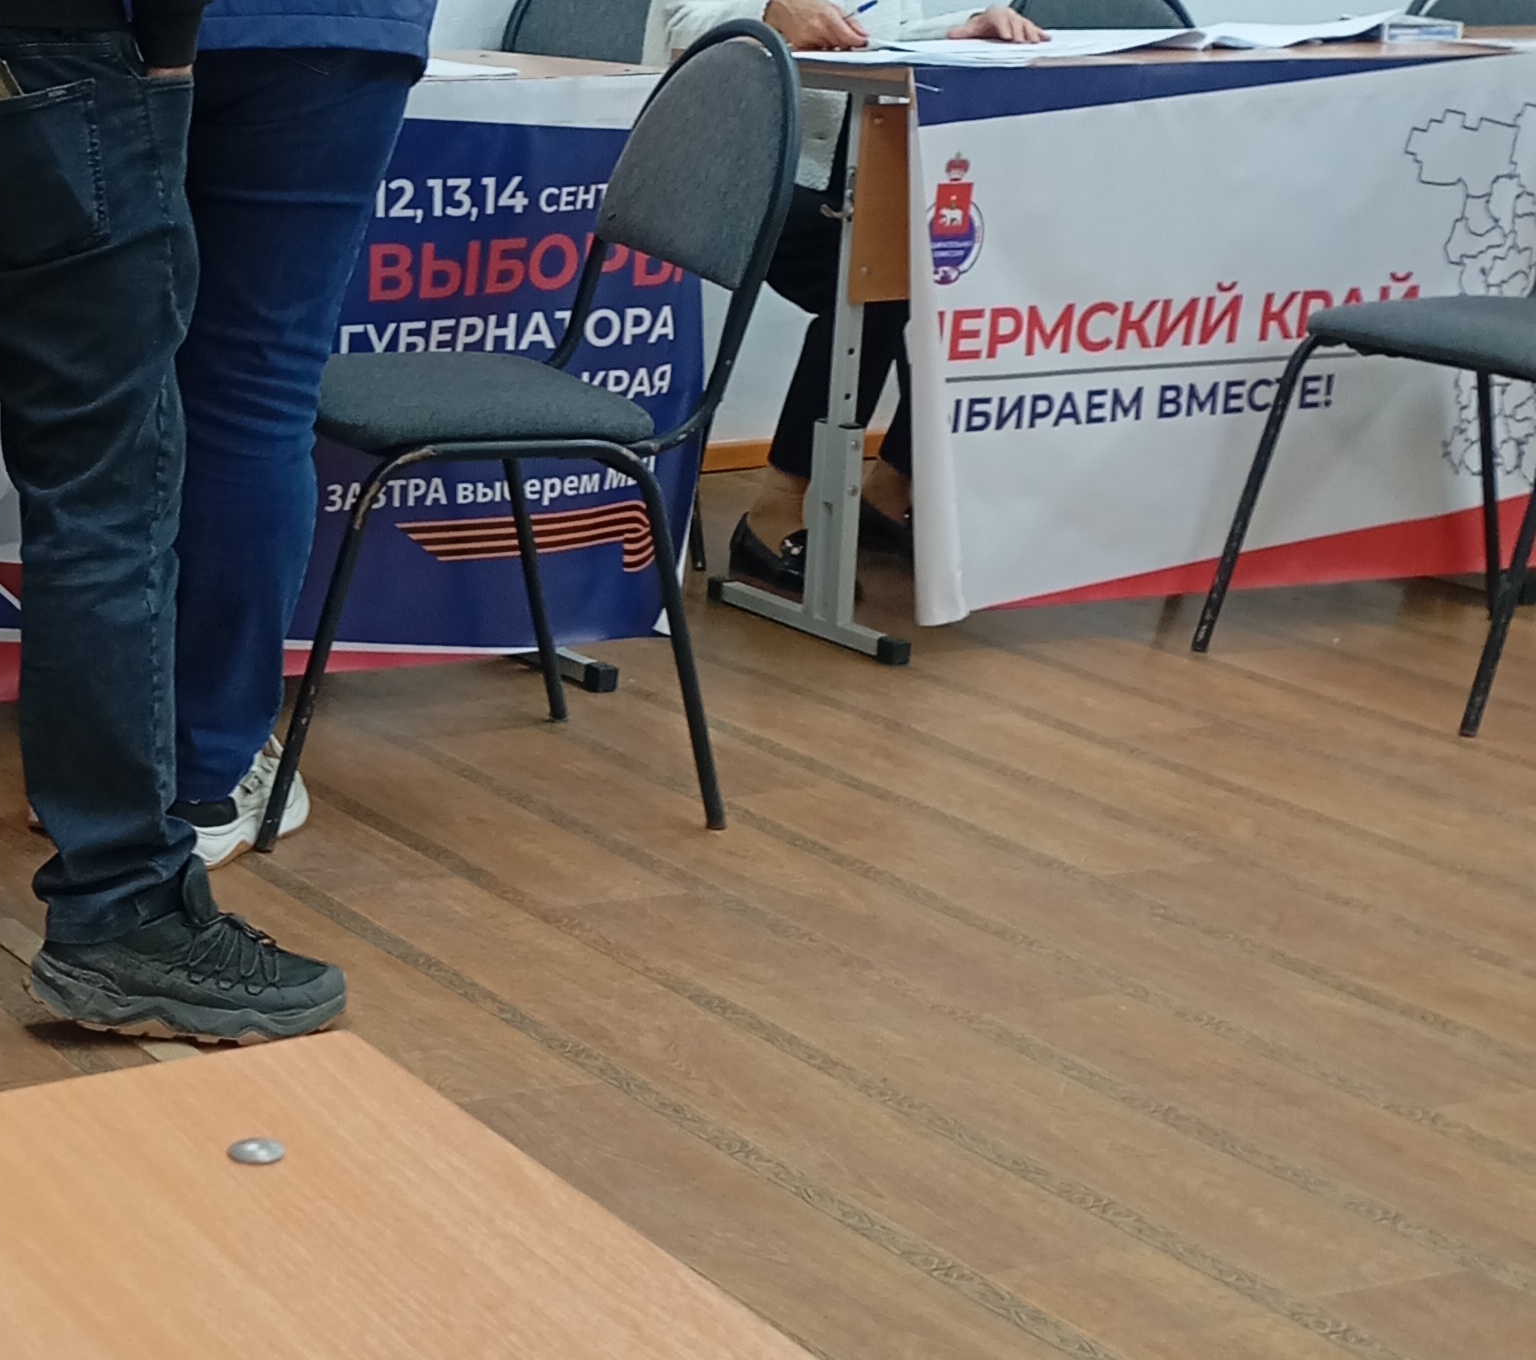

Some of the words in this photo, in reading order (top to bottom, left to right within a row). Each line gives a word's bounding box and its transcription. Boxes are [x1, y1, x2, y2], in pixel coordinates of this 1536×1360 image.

[374, 176, 529, 223] 12,13,14
[539, 183, 609, 213] СЕНТ
[938, 281, 1243, 361] ЕРМСКИЙ
[950, 387, 1144, 434] БИРАЕМ
[1157, 373, 1335, 420] ВМЕСЕ!
[456, 472, 600, 506] выерем
